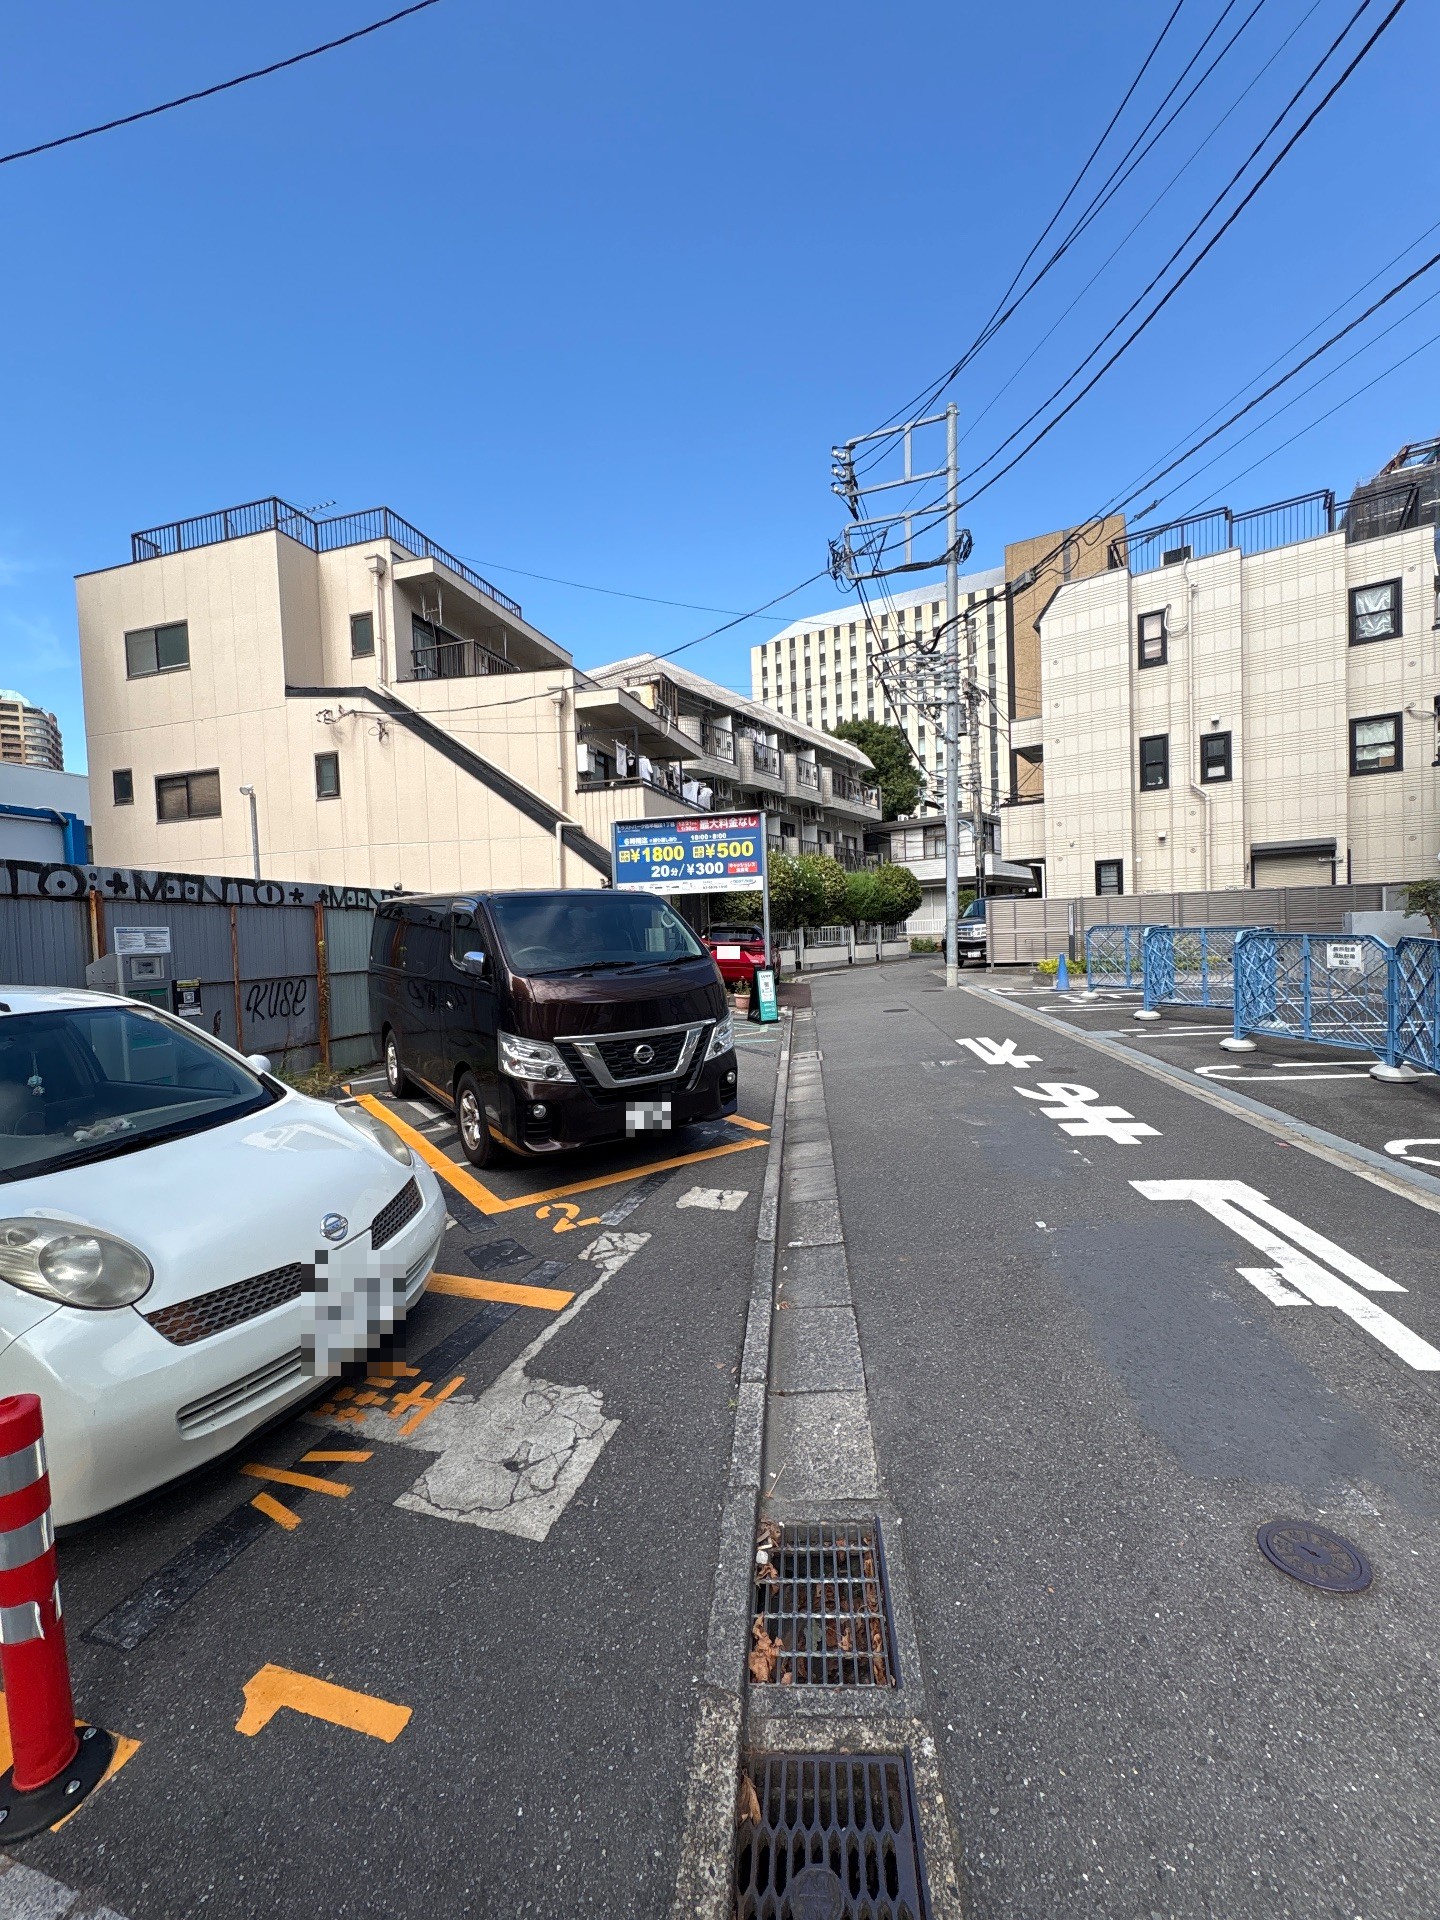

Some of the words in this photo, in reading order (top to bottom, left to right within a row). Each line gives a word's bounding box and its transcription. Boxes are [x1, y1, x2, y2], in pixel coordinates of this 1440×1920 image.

[700, 816, 757, 830] 最大料金なし
[705, 841, 754, 858] ¥500
[536, 1203, 602, 1233] 2
[235, 1663, 413, 1743] 1
